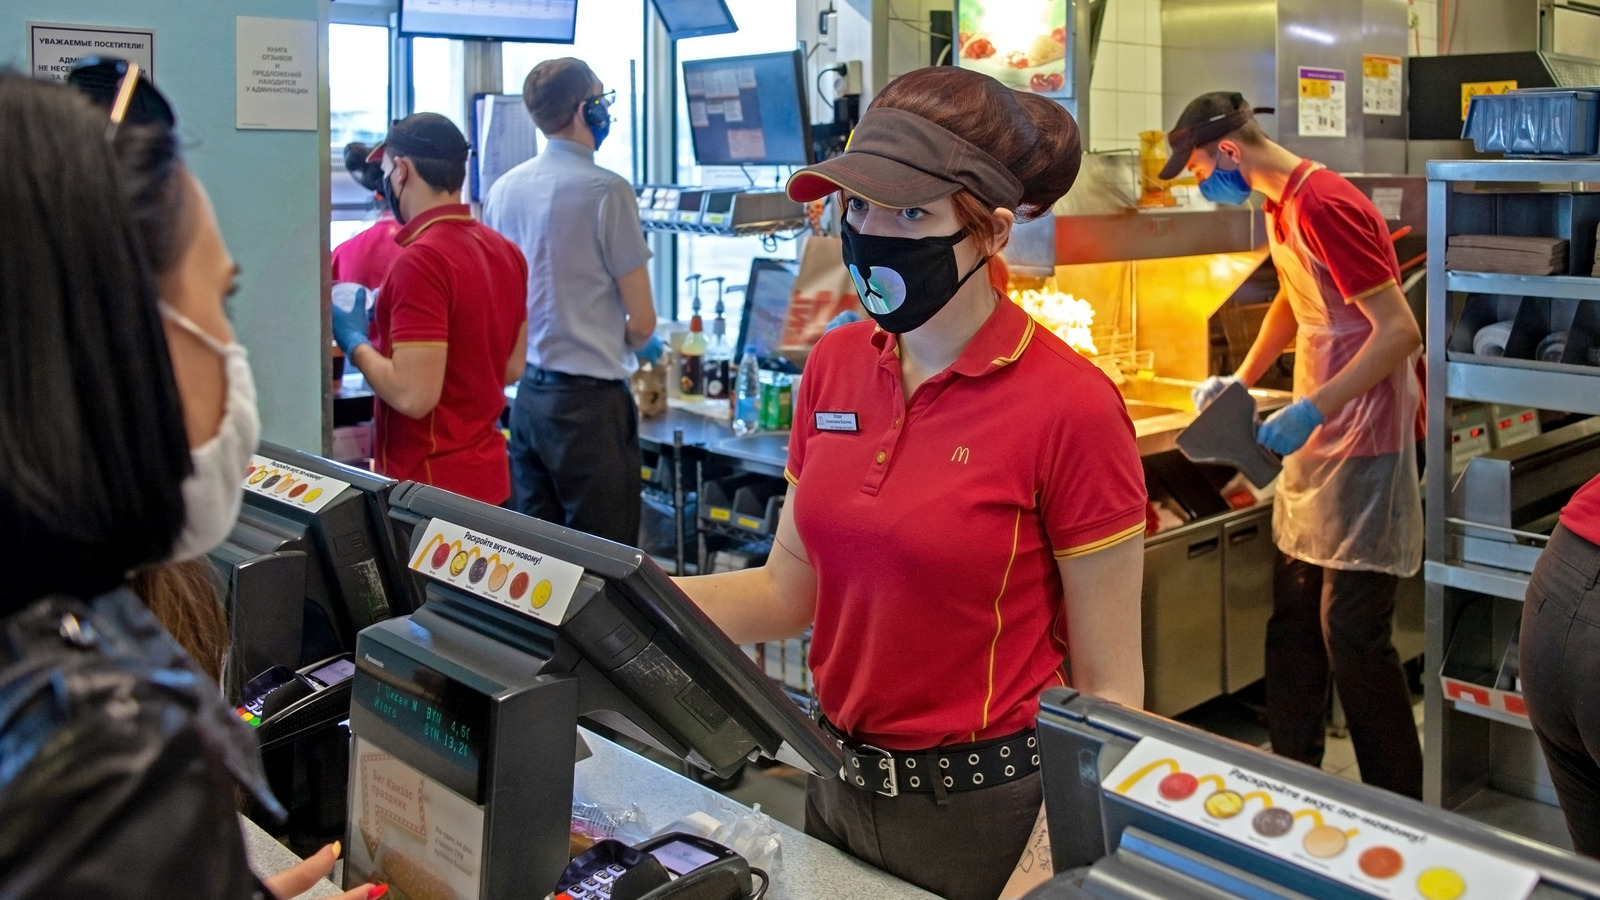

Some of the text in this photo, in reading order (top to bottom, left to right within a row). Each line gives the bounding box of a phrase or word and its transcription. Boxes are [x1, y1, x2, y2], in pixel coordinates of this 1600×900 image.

[39, 37, 145, 50] УВАЖАЕМЫЕ ПОСЕТИТЕЛИ!
[266, 46, 288, 54] КНИГА
[261, 54, 293, 62] ОТЗЫВОВ
[252, 69, 302, 79] ПРЕДЛОЖЕНИЙ
[258, 78, 297, 86] НАХОДИТСЯ
[251, 86, 309, 95] АДМИНИСТРАЦИИ
[463, 531, 543, 566] Раскройте вкус по-новому!
[365, 653, 385, 669] Panasonic
[426, 706, 442, 724] BYN
[424, 722, 440, 741] BYN
[372, 769, 414, 801] Биг Канзас
[1229, 767, 1301, 799] Раскройте
[1301, 795, 1335, 813] вкус
[371, 784, 407, 811] праздник
